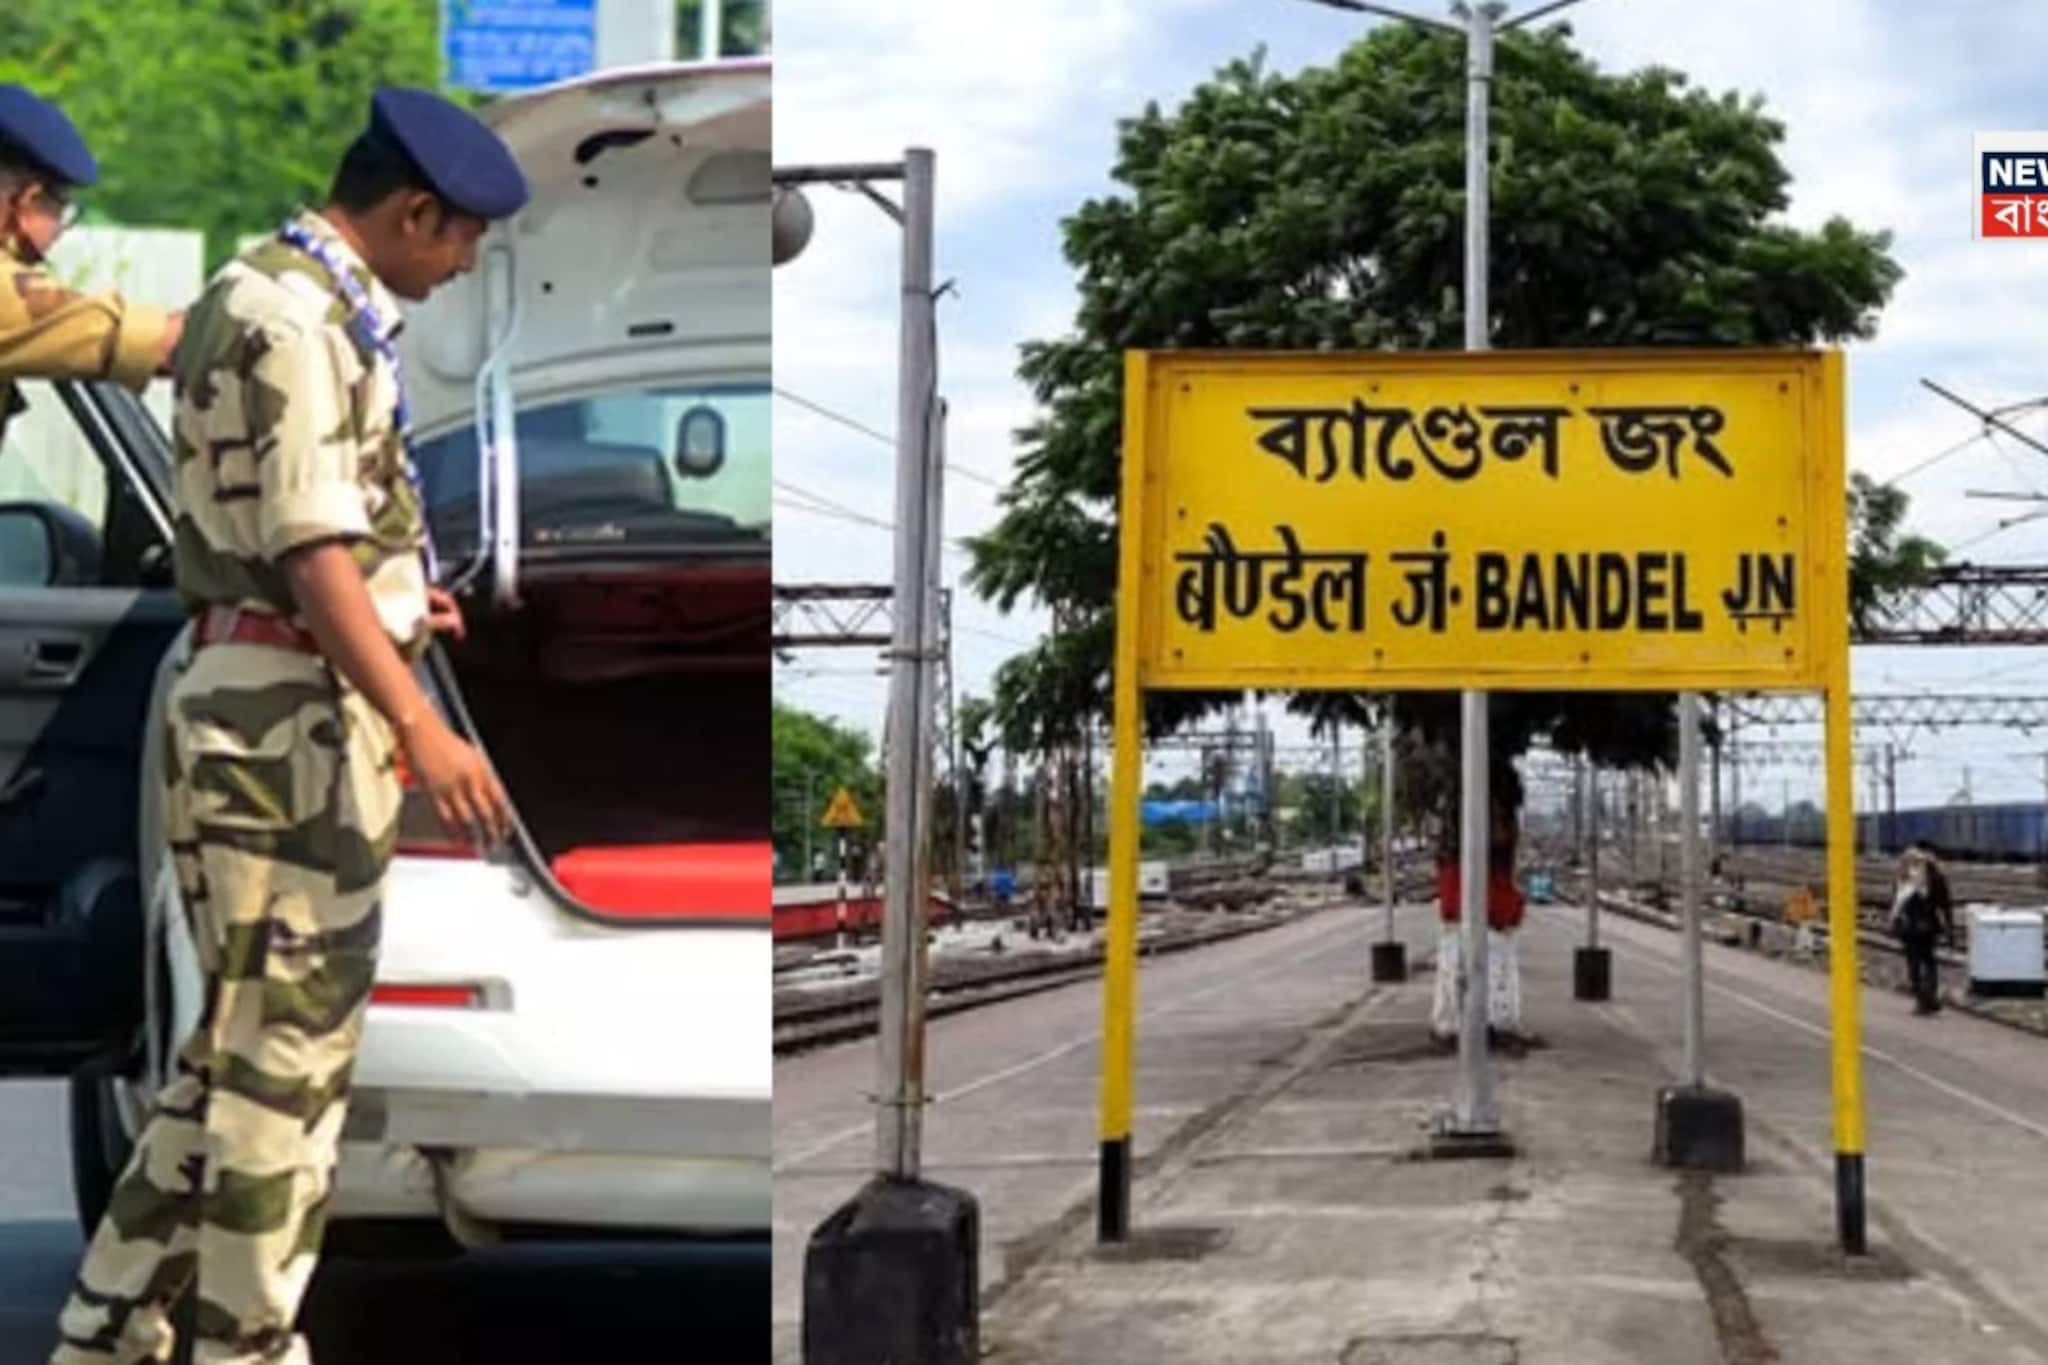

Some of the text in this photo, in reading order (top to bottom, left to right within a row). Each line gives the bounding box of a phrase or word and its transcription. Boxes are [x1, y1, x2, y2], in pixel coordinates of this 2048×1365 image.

[1246, 397, 1735, 483] ব্যাণ্ডেল জং
[1475, 552, 1704, 632] BANDEL
